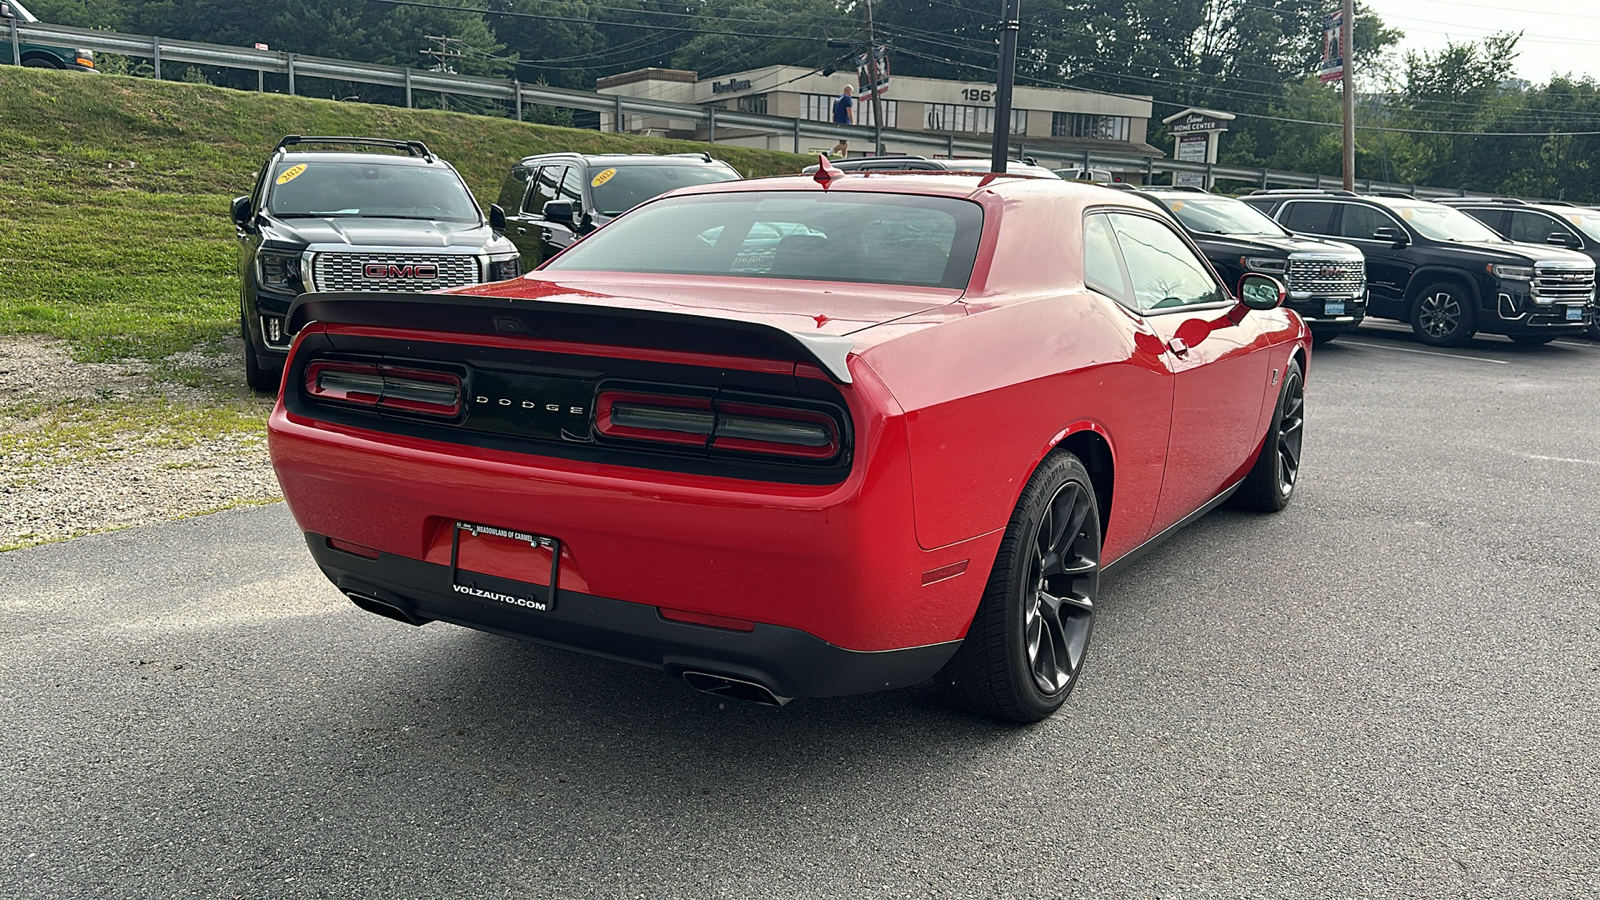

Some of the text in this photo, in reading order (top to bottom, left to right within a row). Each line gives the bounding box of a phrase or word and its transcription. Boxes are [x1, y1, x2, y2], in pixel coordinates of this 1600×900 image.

[1174, 122, 1216, 132] HOME CENTER
[281, 166, 302, 181] 2021
[595, 169, 614, 184] 2022
[365, 264, 436, 279] GMC
[476, 395, 584, 415] DODGE
[476, 525, 507, 538] MEADOWLAND
[508, 531, 514, 539] OF
[514, 532, 533, 542] CARMEL
[453, 584, 546, 611] VOLZAUTO.COM
